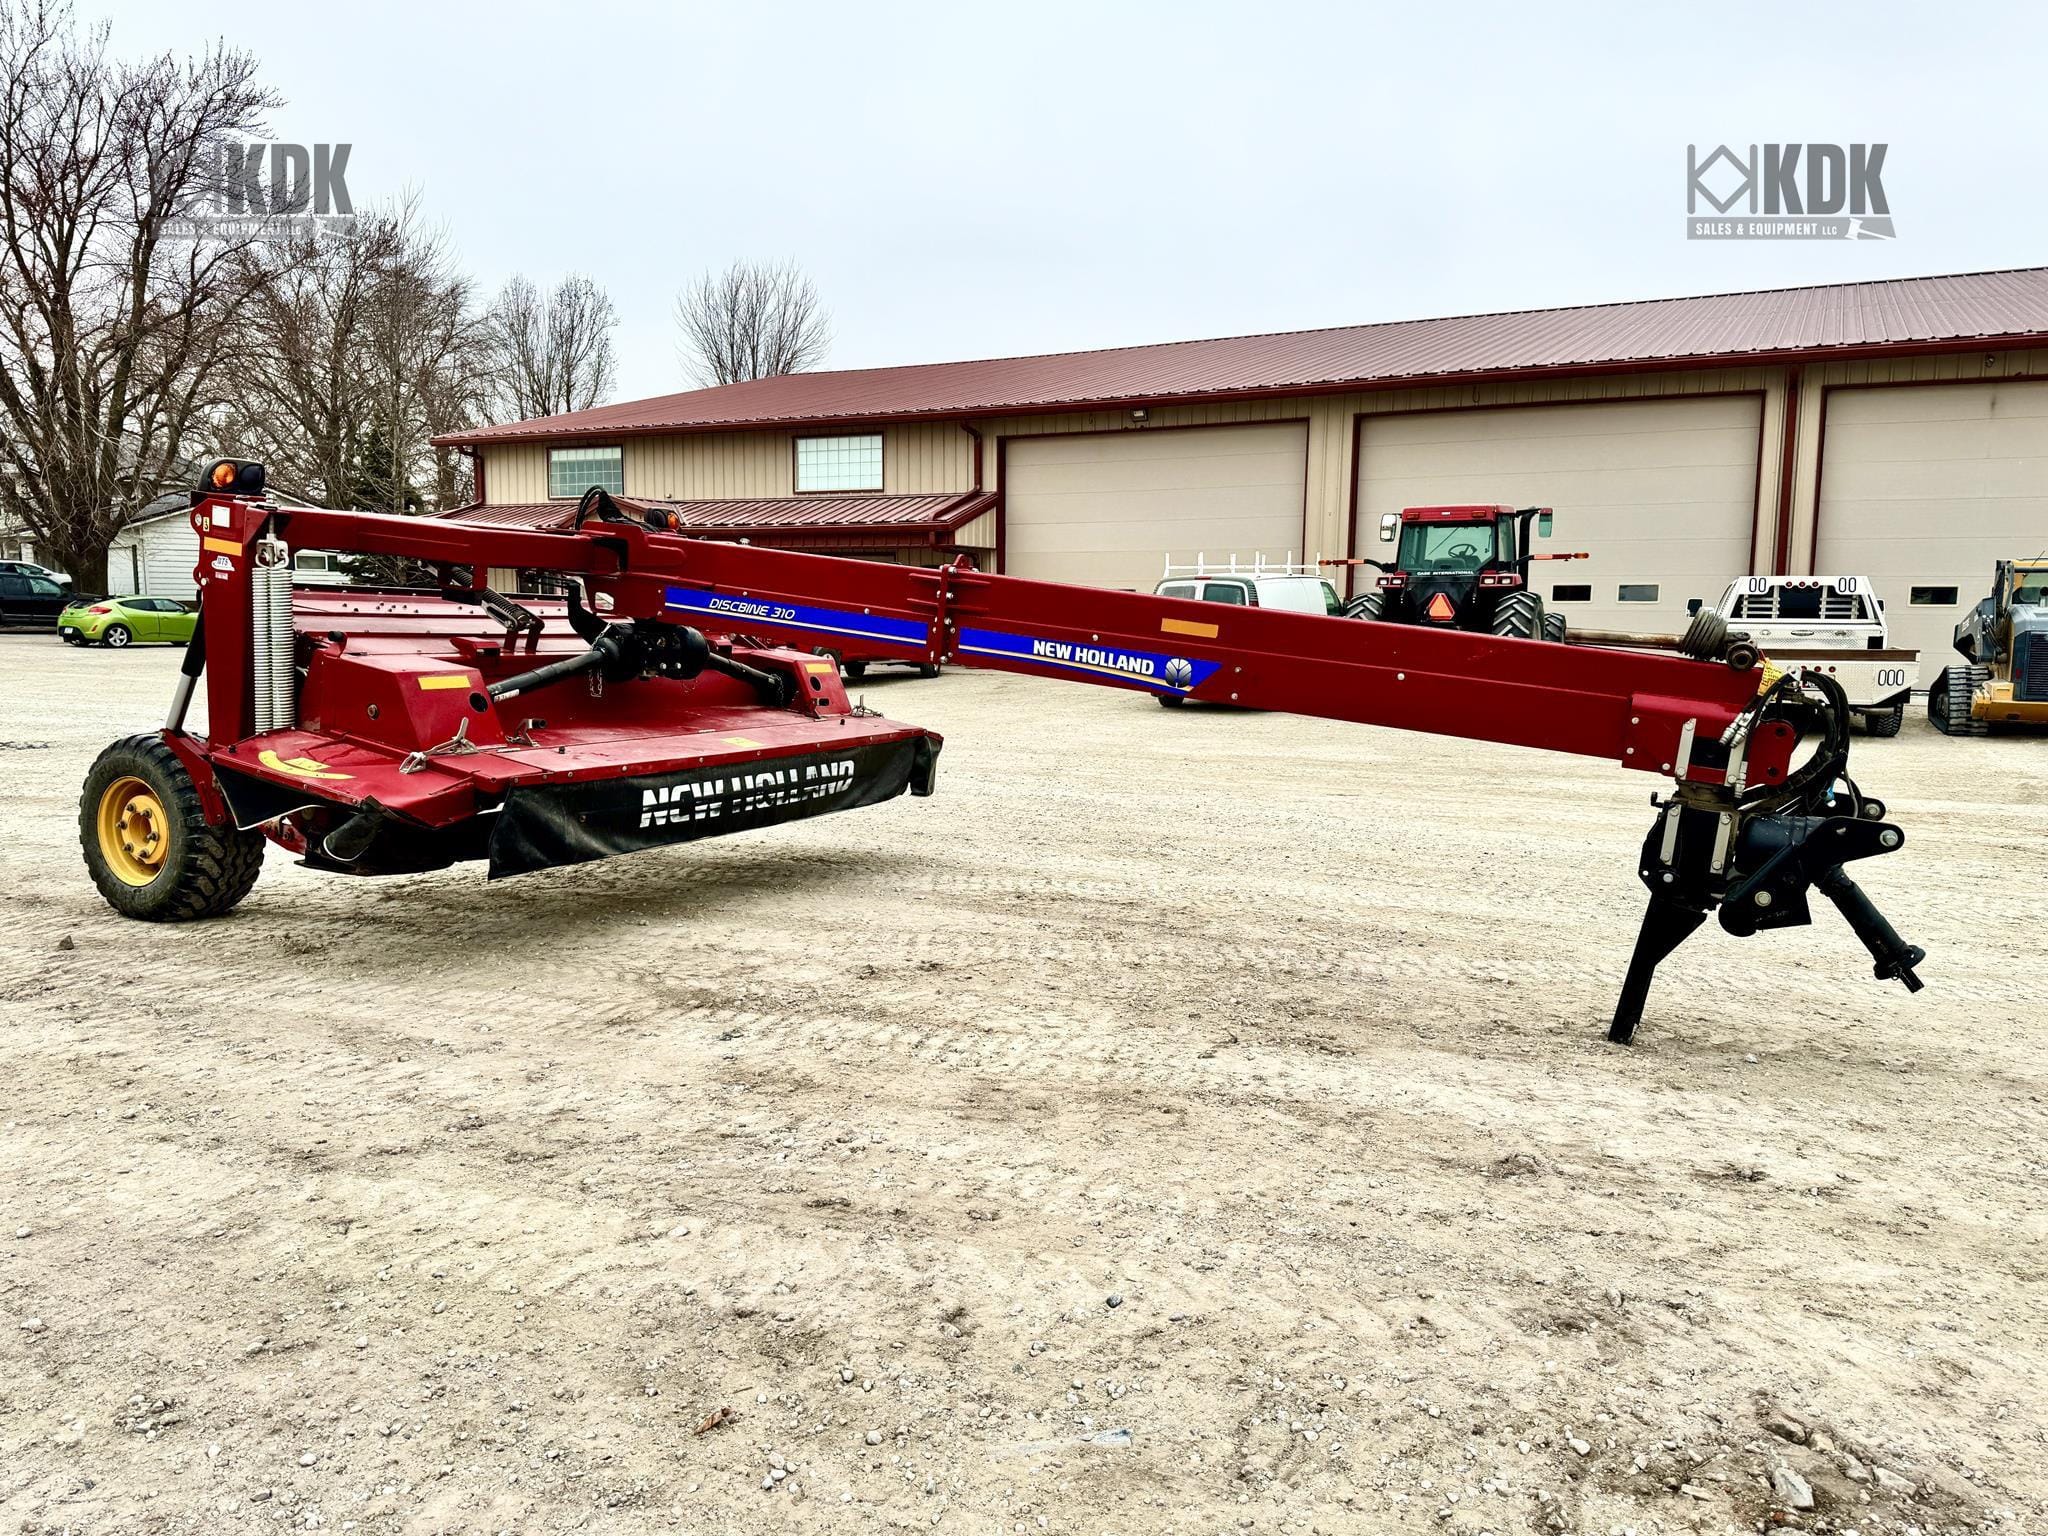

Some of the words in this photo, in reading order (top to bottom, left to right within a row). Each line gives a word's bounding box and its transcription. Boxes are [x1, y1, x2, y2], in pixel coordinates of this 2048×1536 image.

[709, 598, 770, 616] DISCBINE
[771, 607, 795, 620] 310
[1033, 640, 1072, 660] NEW
[1075, 647, 1154, 675] HOLLAND
[639, 779, 723, 828] NEW
[731, 760, 855, 814] HOLLAND
